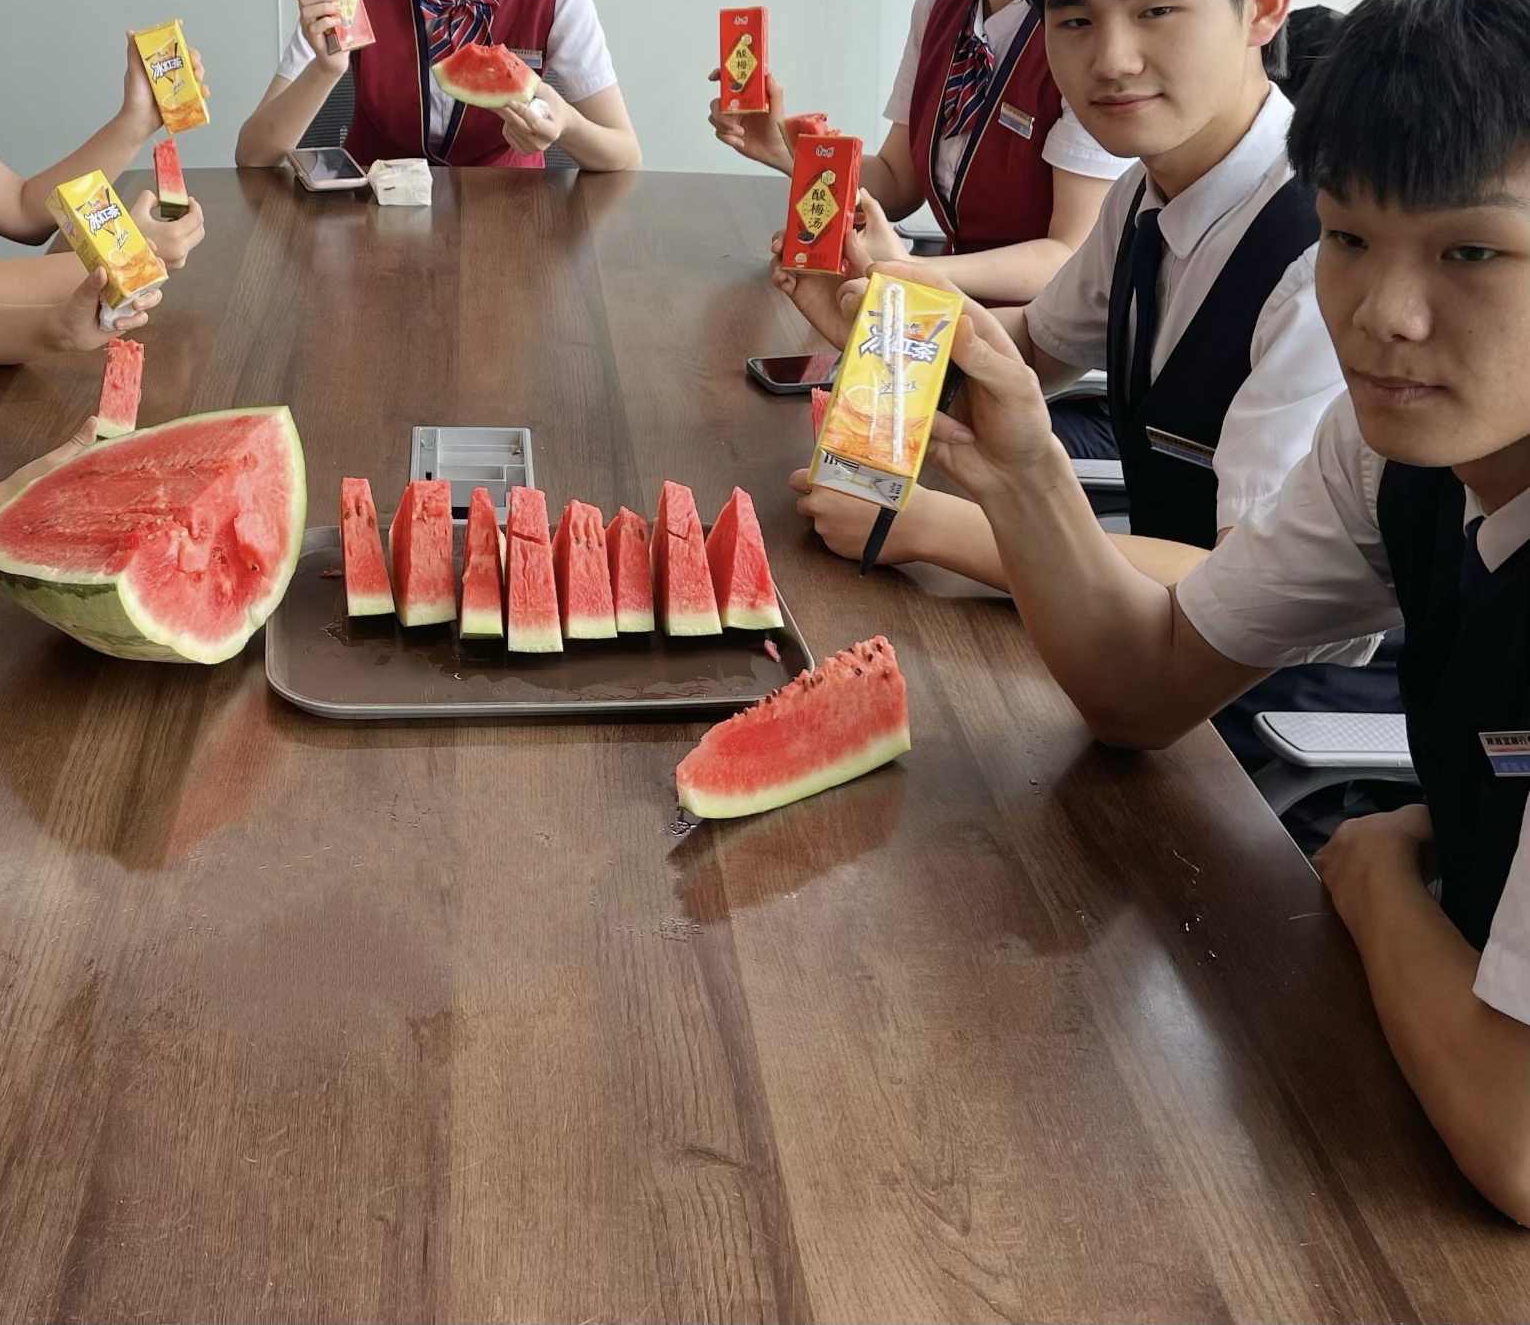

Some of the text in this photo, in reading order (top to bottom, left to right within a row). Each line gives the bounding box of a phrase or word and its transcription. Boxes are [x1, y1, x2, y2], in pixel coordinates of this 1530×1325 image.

[84, 204, 121, 235] 冰红茶
[808, 189, 826, 229] 酸梅汤
